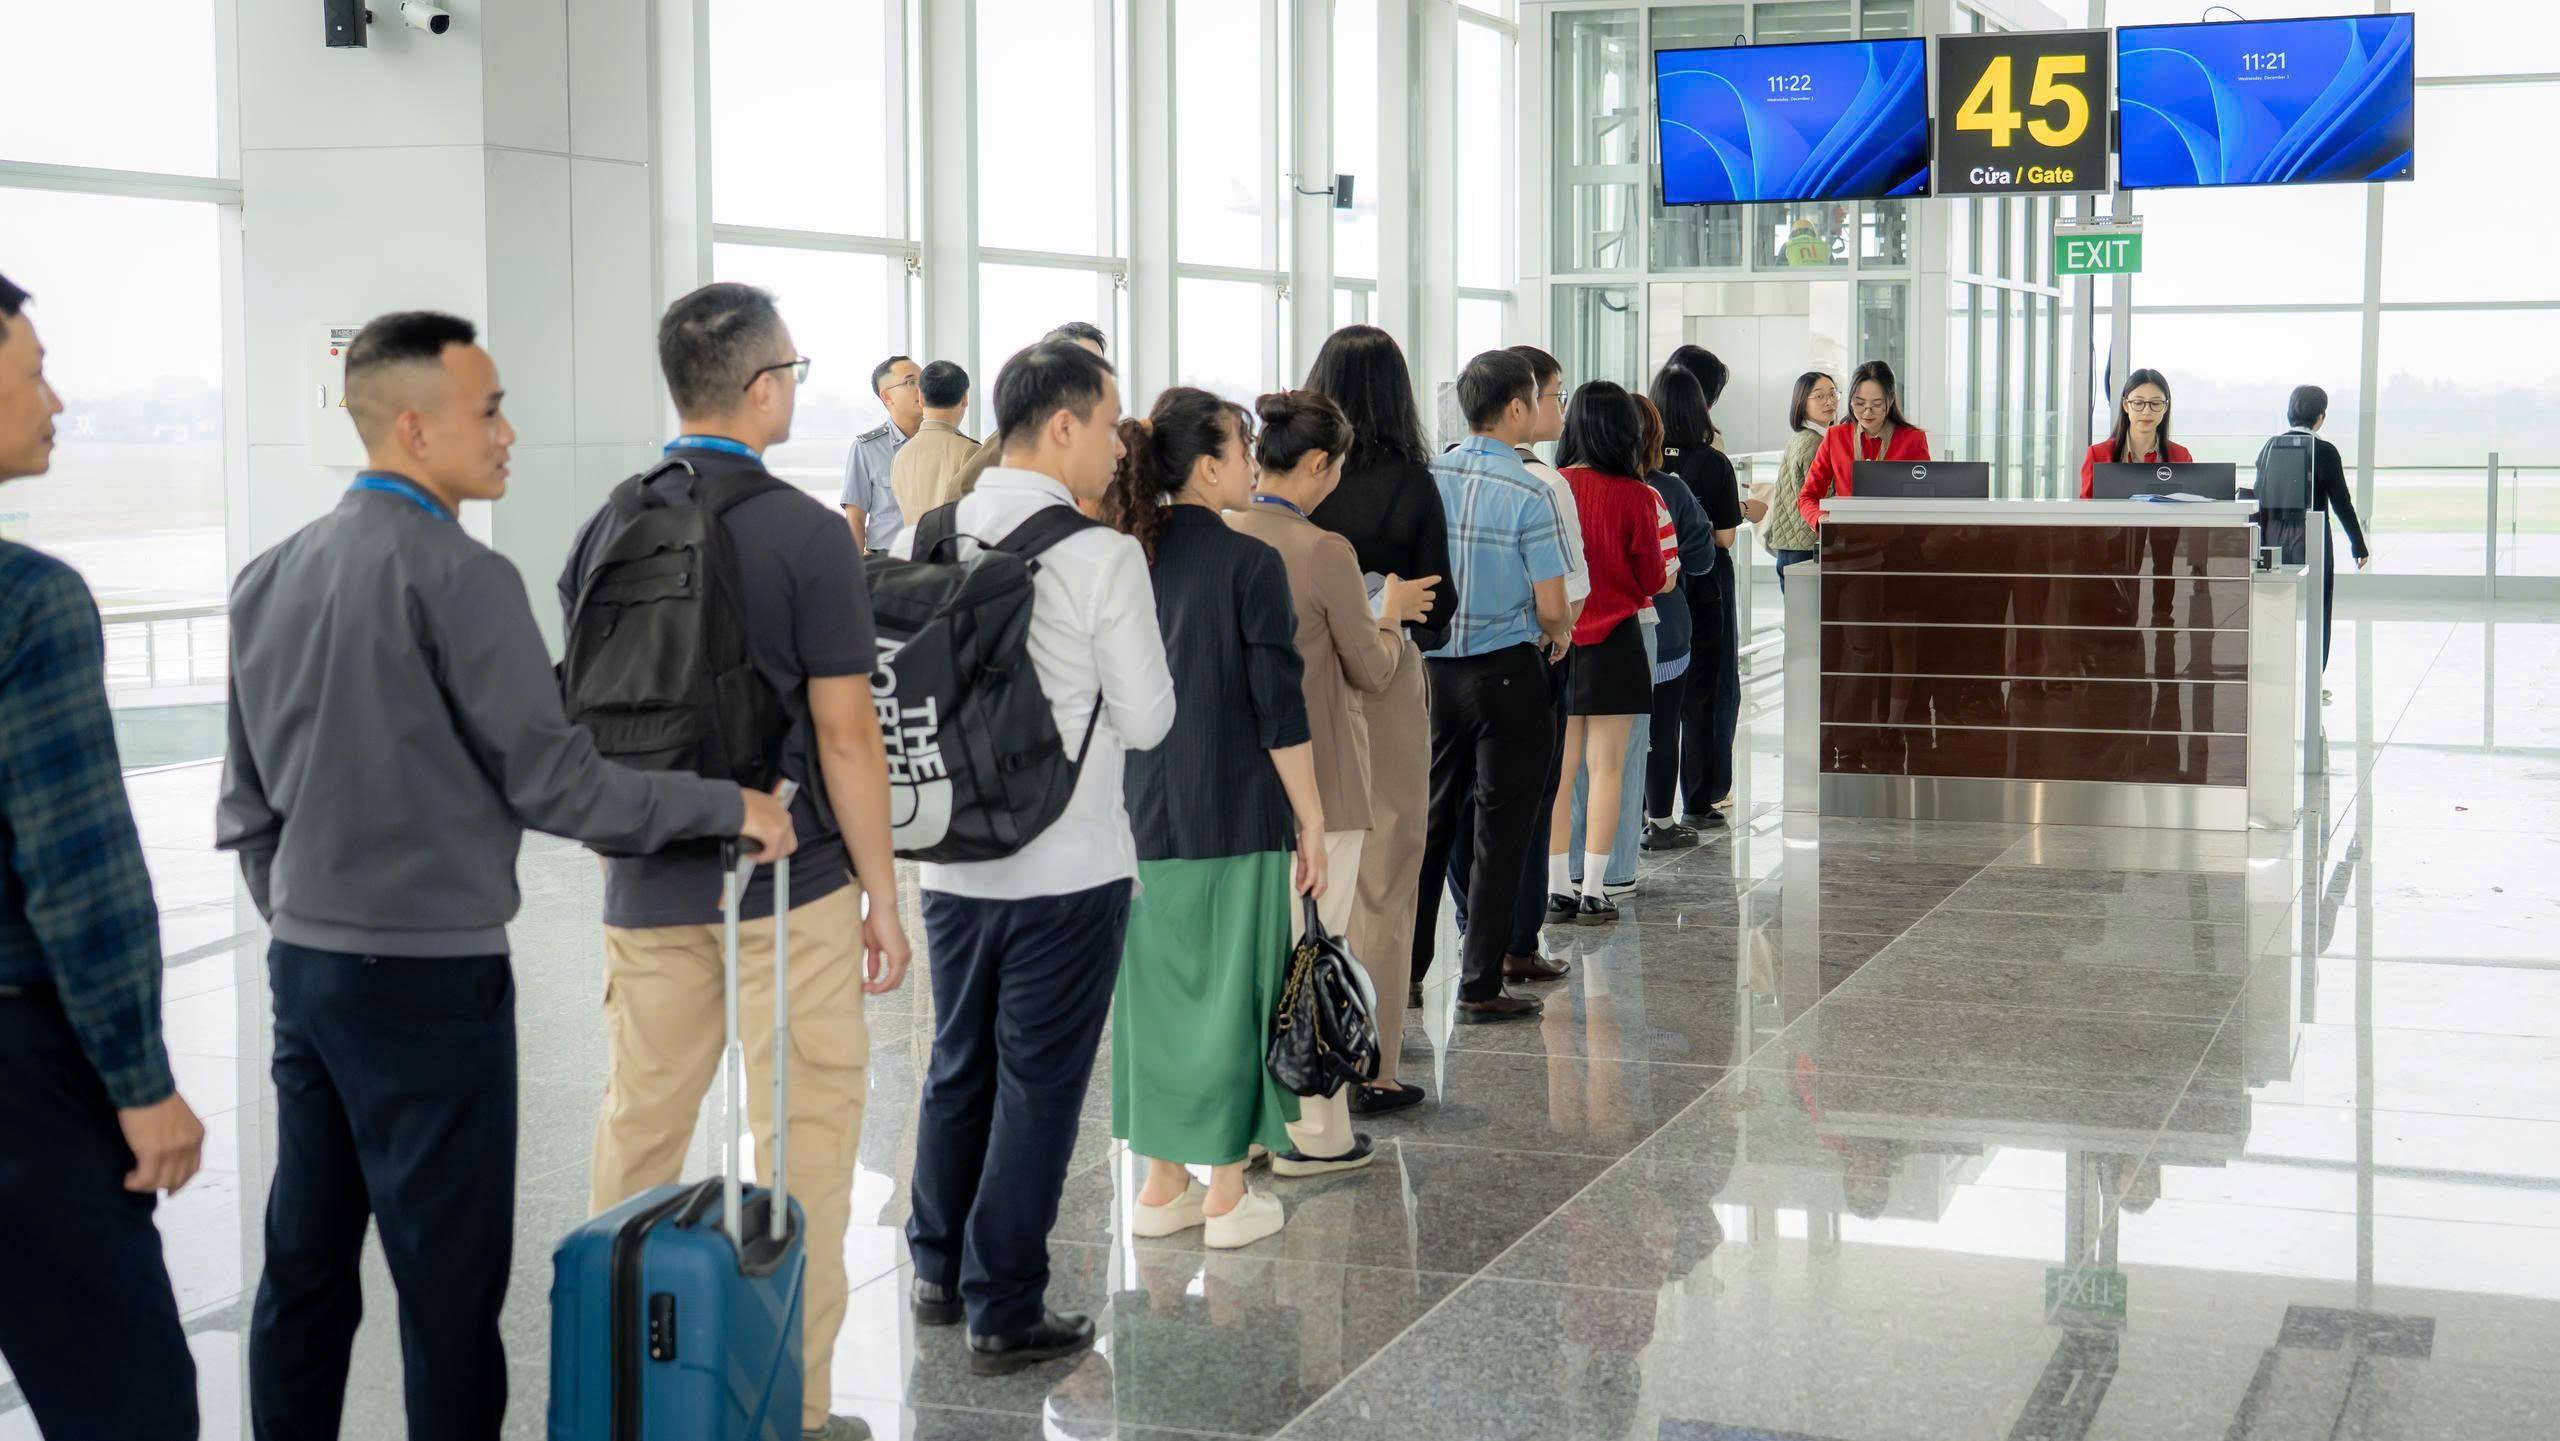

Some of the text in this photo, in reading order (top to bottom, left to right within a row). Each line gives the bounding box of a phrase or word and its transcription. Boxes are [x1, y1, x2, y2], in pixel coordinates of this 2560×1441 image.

[2242, 52, 2286, 70] 11:21
[1767, 74, 1812, 92] 11:22
[1956, 55, 2090, 147] 45
[1969, 166, 2074, 185] Cửa / Gate
[2067, 240, 2131, 269] EXIT
[867, 637, 912, 785] NORTH
[900, 696, 948, 784] THE
